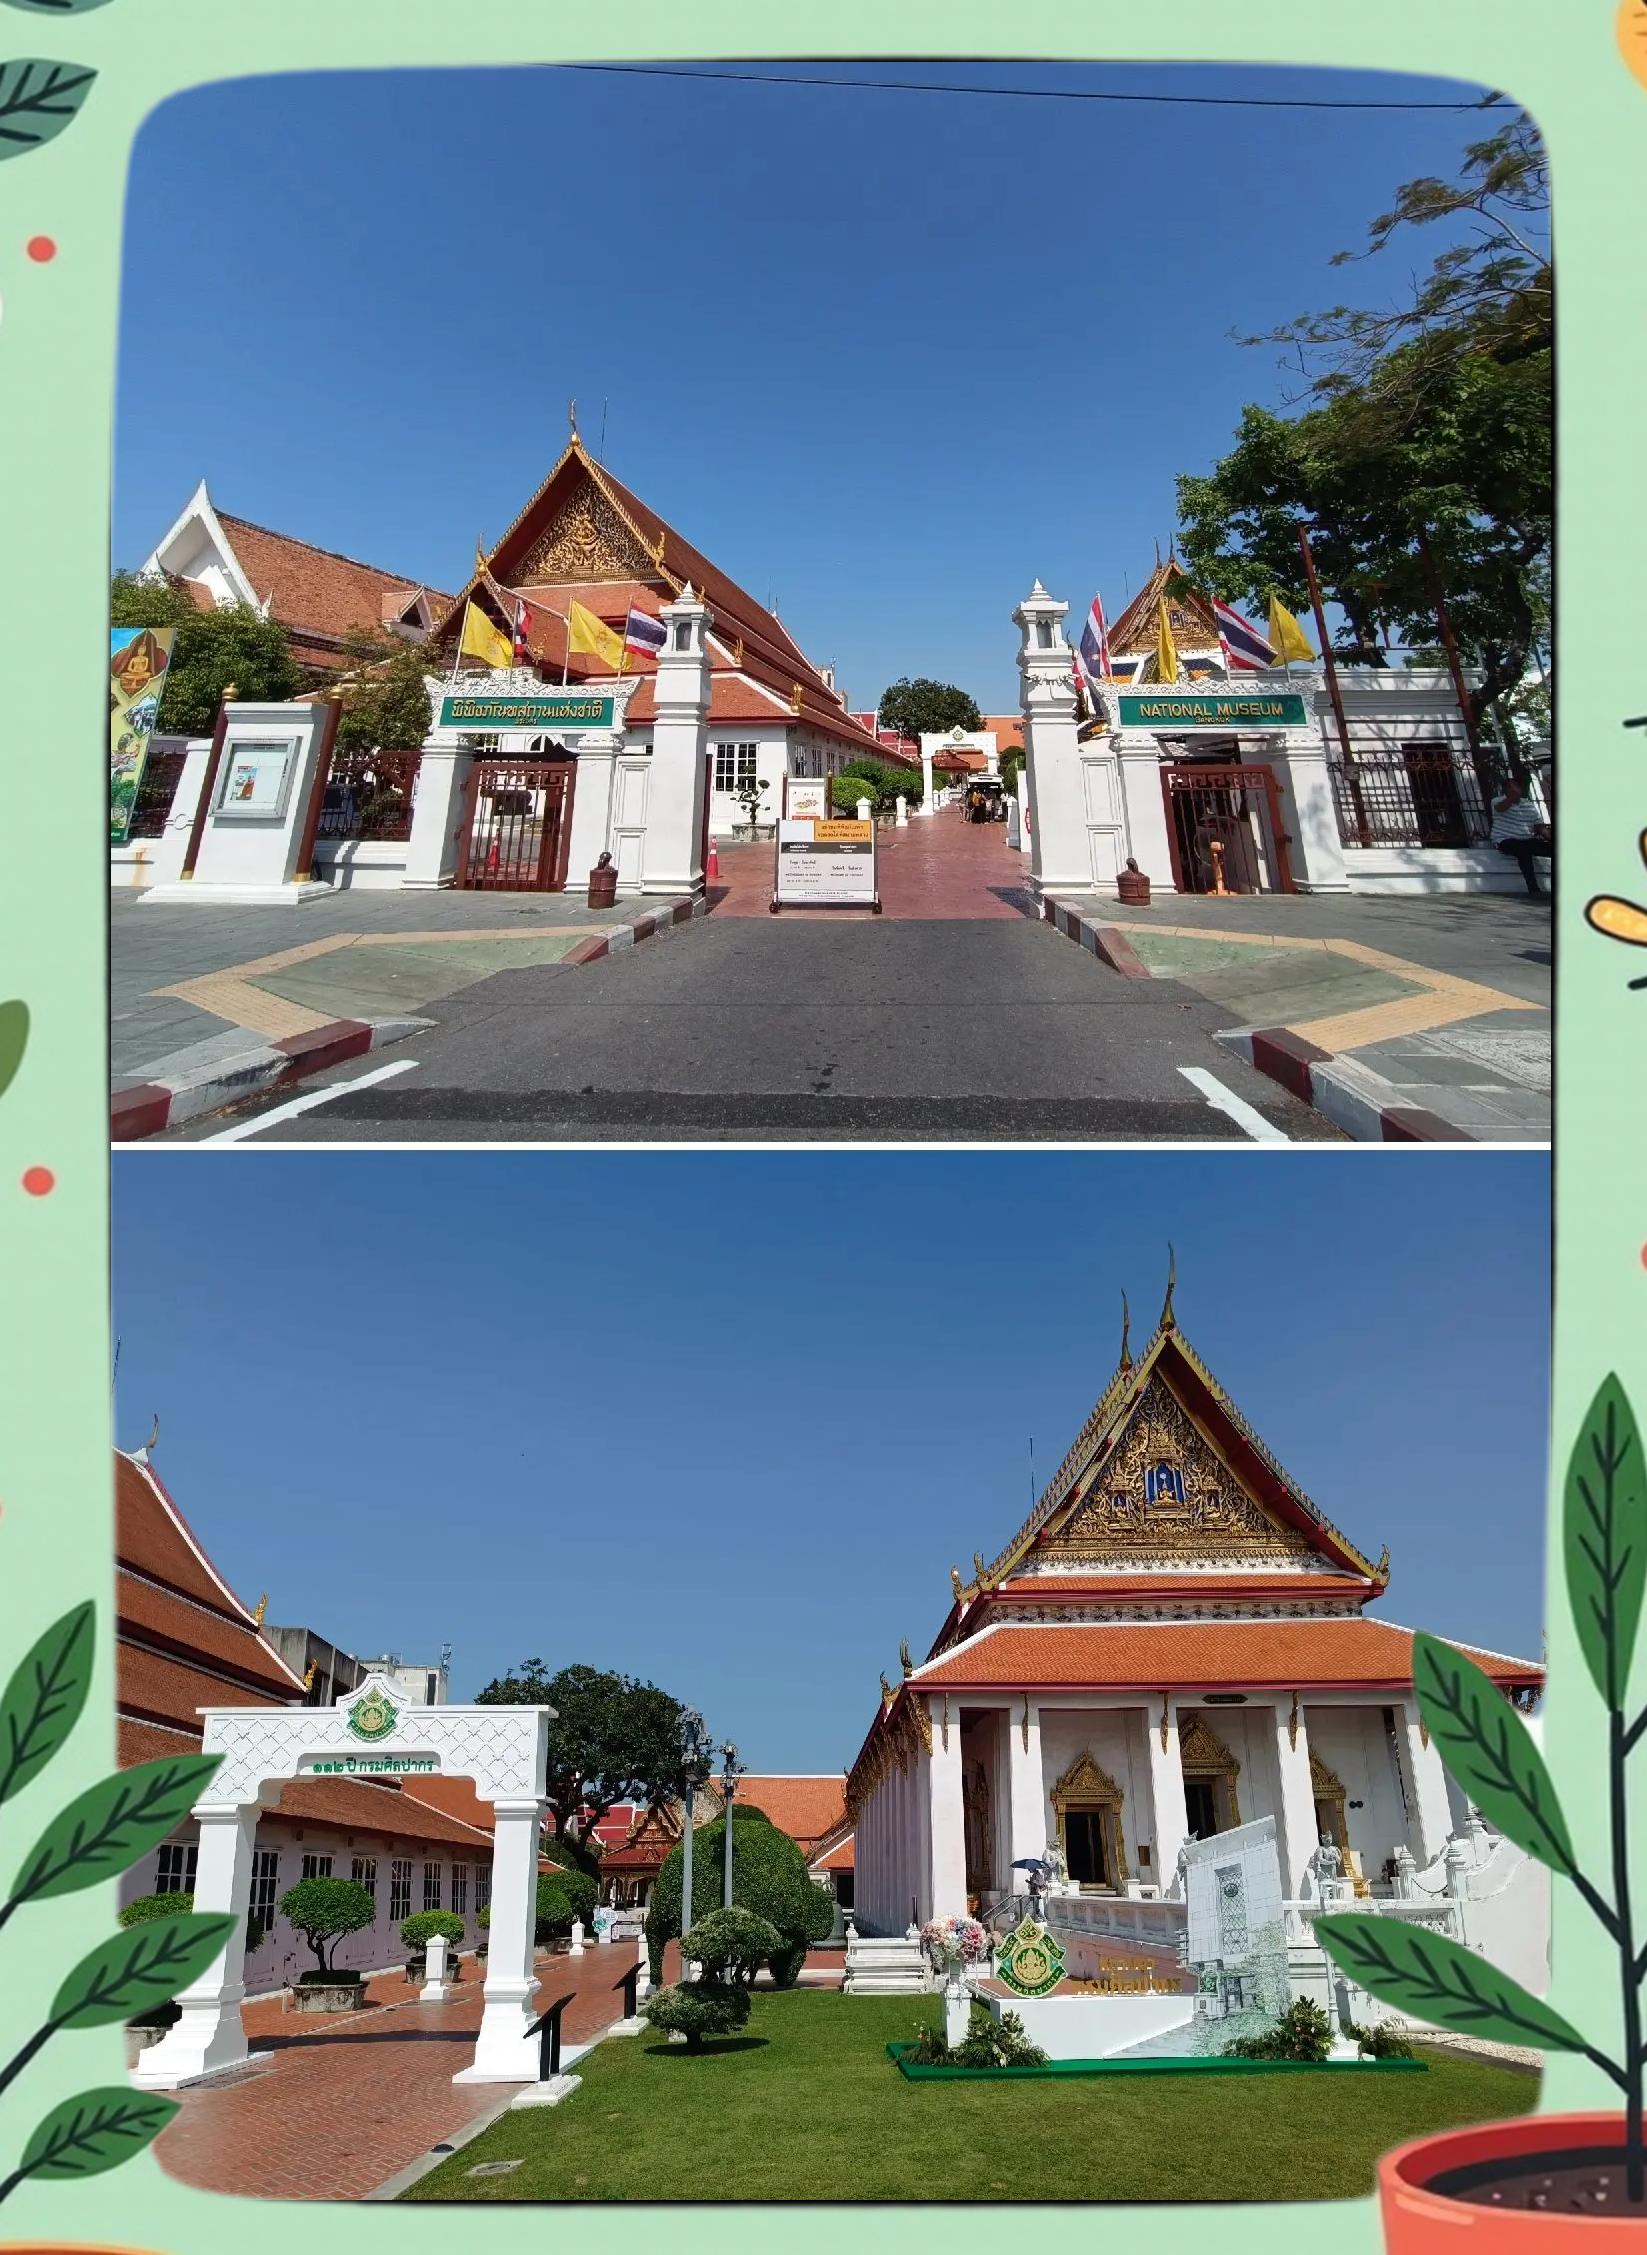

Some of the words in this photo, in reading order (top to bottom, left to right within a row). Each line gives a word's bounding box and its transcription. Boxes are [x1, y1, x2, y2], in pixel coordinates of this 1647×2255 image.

[452, 699, 603, 718] พิพิธภัณฑสถานแห่งชาติ
[1139, 703, 1212, 717] NATIONAL
[1217, 702, 1284, 716] MUSEUM
[313, 1761, 344, 1774] ๑๑๒
[360, 1756, 434, 1773] กรมศิลปากร
